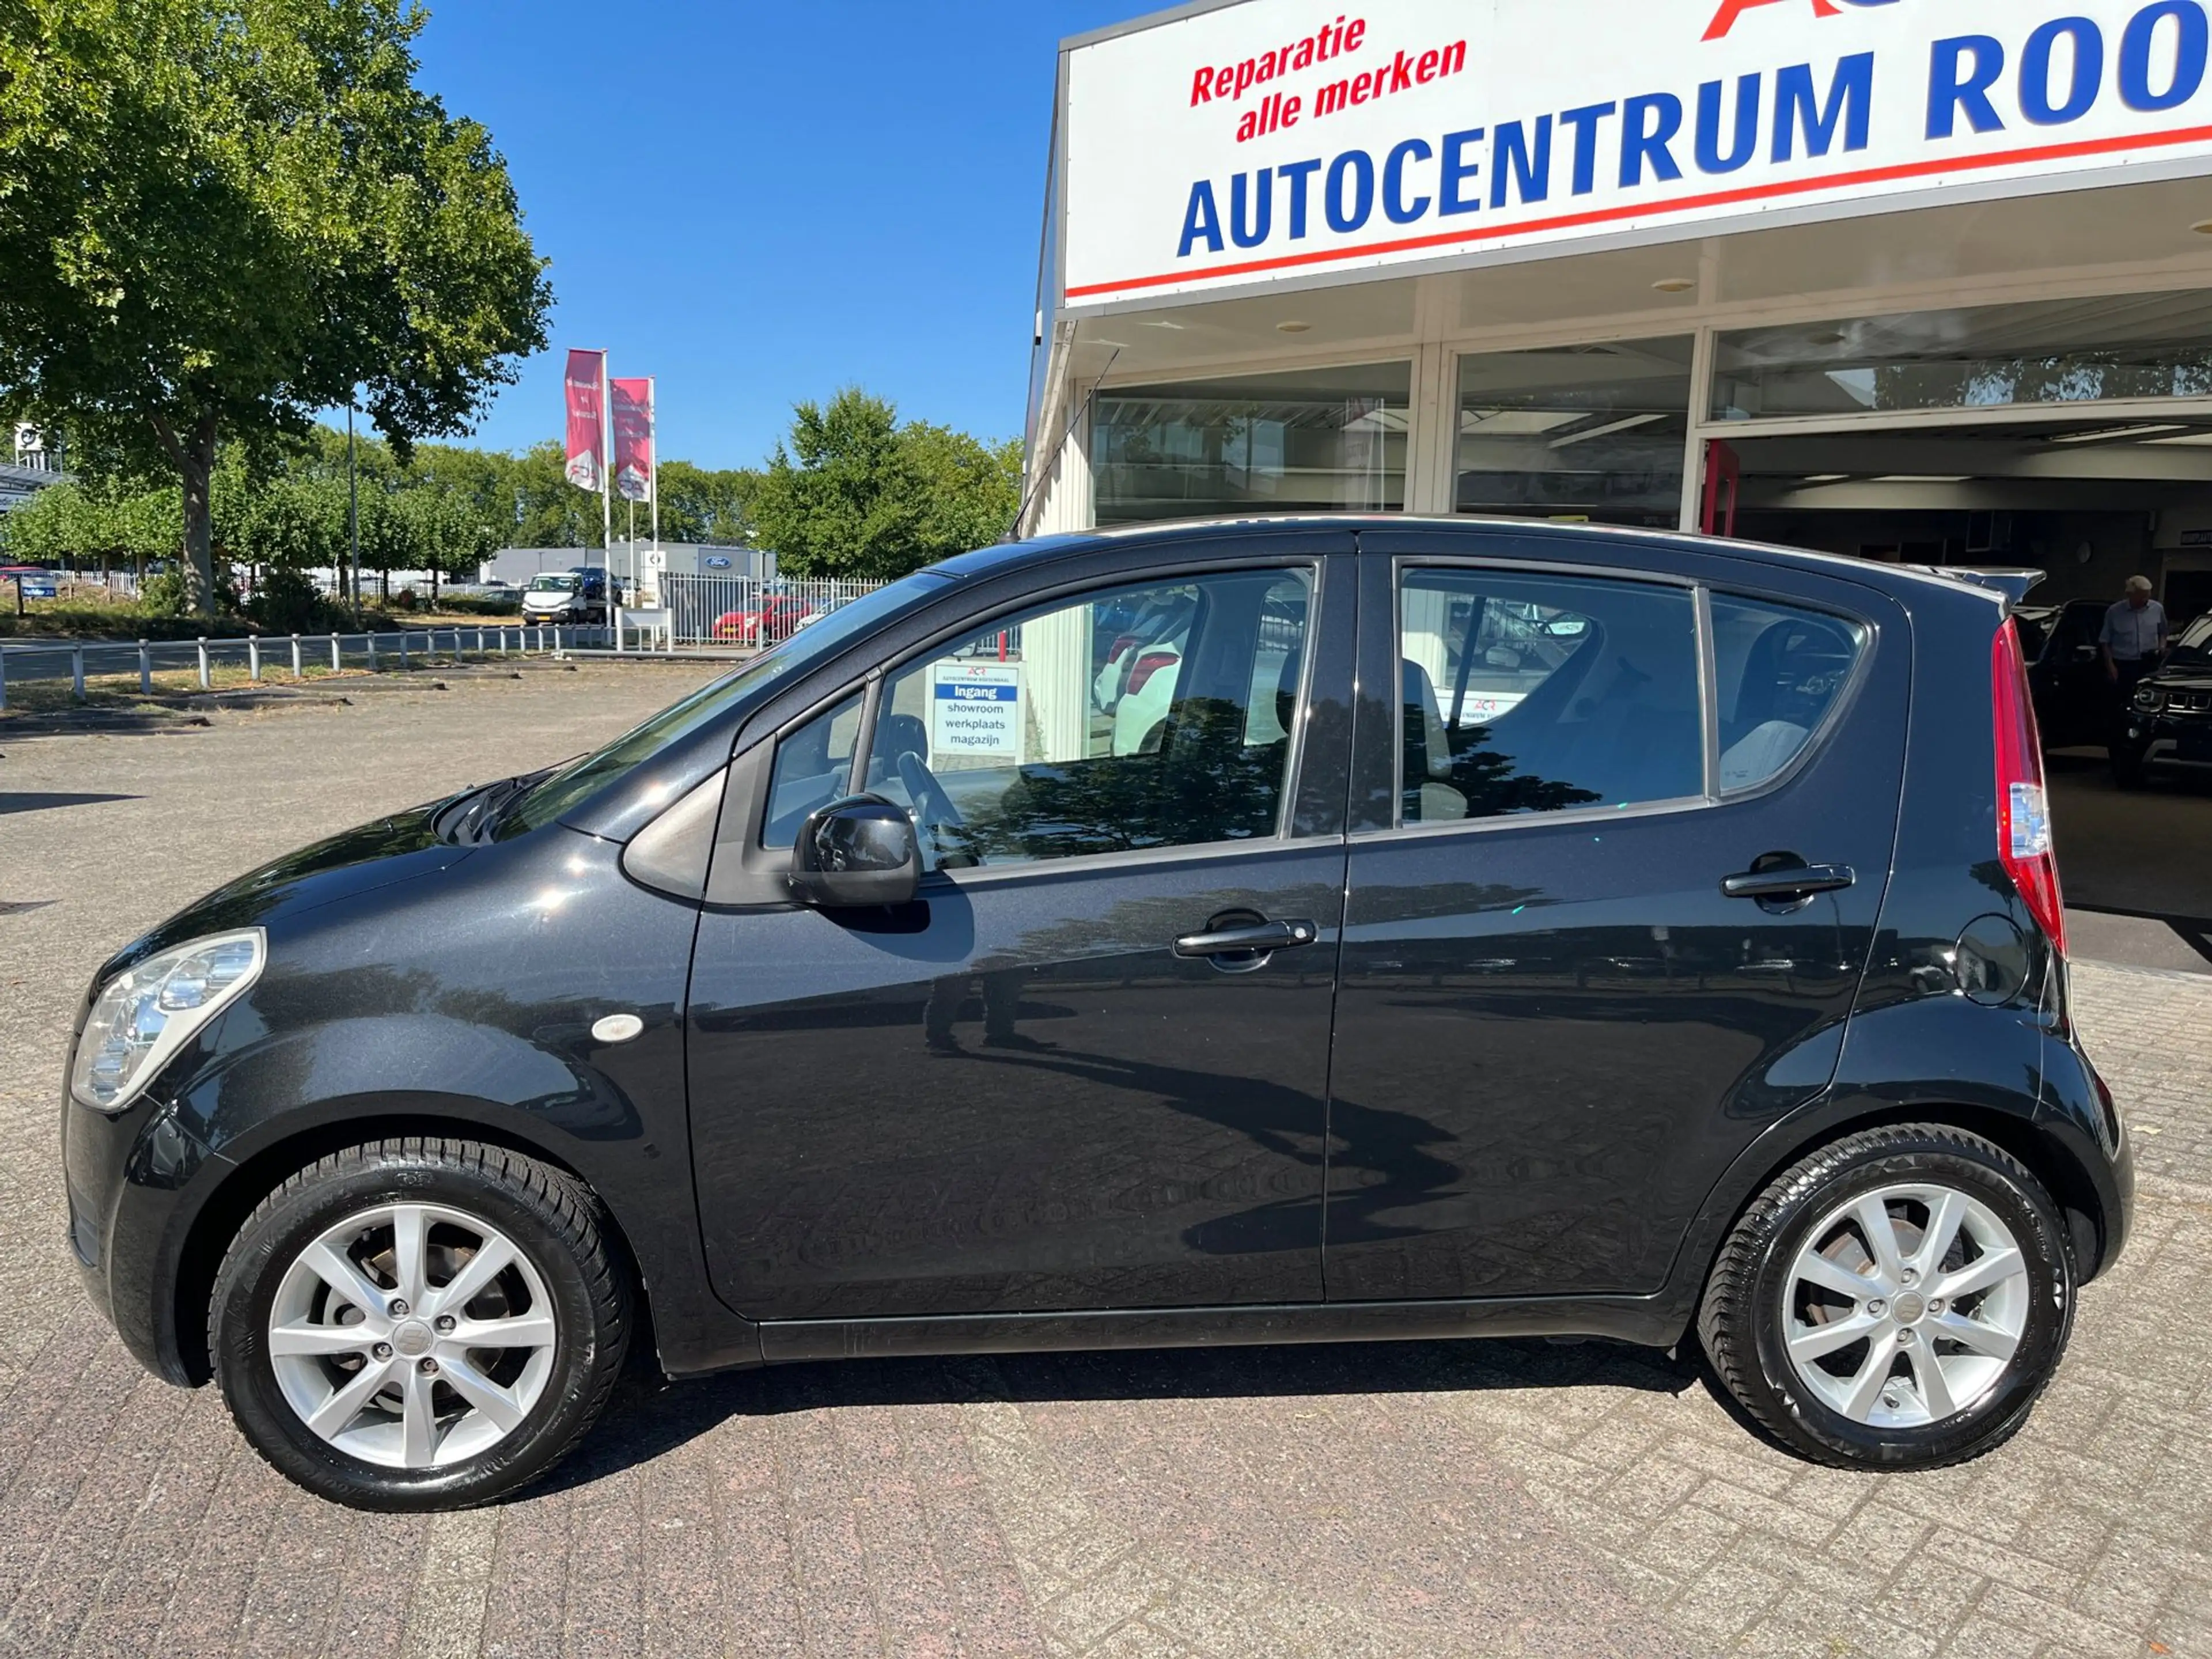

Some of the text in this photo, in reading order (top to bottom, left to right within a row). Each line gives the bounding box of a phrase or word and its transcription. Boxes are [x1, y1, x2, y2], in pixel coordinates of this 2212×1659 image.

[1190, 15, 1366, 108] Reparatie
[1236, 39, 1467, 143] alle merken
[1177, 0, 2210, 257] AUTOCENTRUM ROO
[954, 685, 998, 700] Ingang
[946, 702, 1004, 714] showroom
[945, 719, 1006, 730] werkplaats
[950, 734, 1000, 747] magazijn
